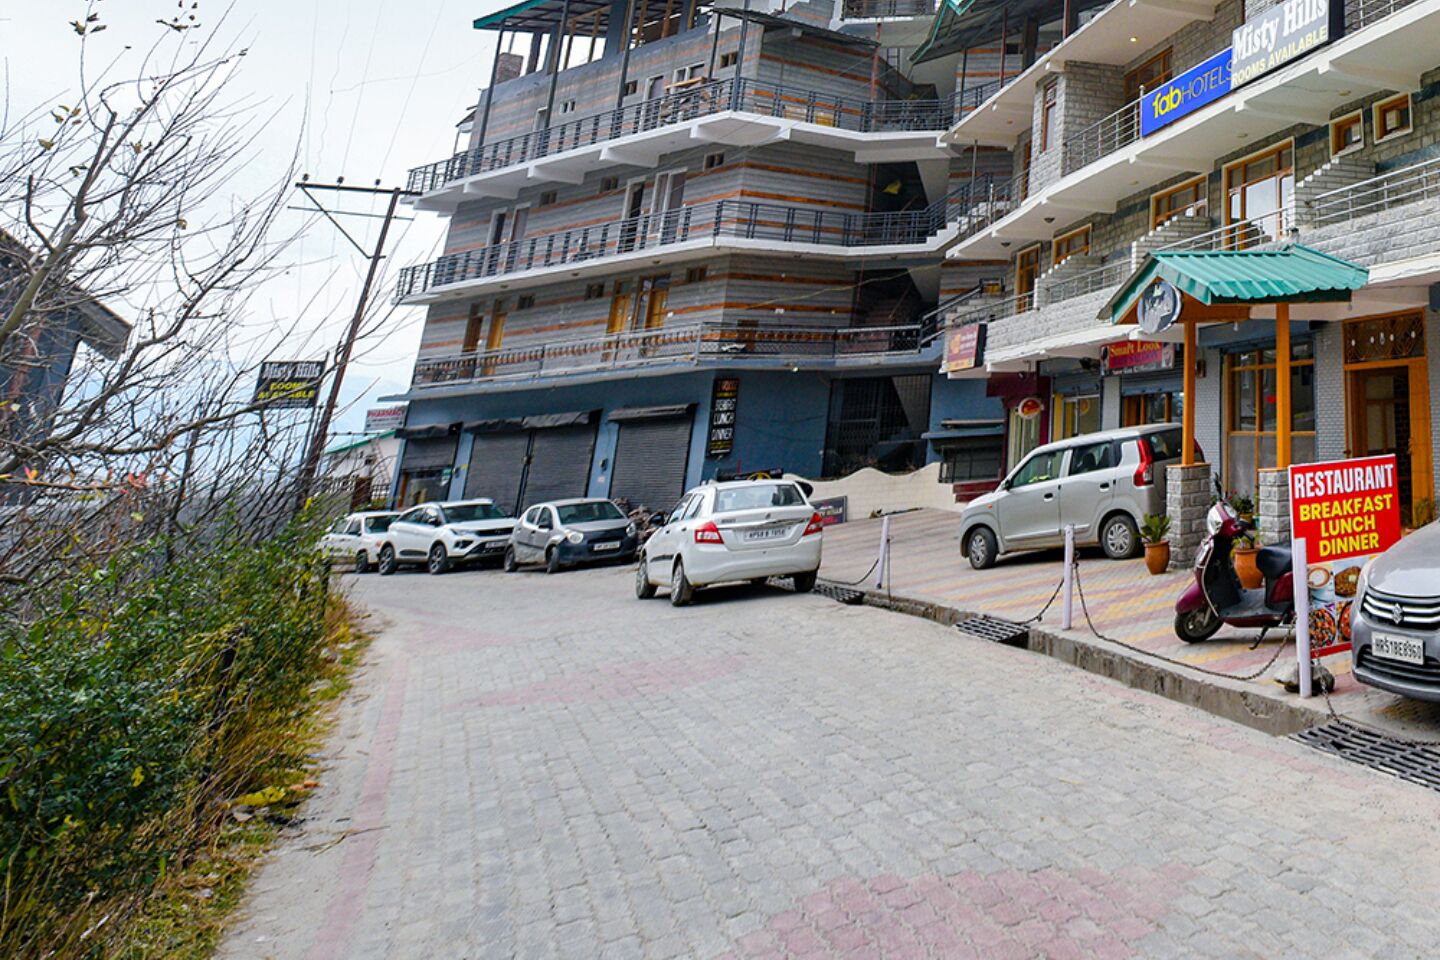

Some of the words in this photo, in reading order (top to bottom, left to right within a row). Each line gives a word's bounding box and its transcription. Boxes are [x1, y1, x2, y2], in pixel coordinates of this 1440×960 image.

[1231, 58, 1266, 87] ROOMS
[1268, 25, 1327, 69] AVAILABLE
[1233, 17, 1280, 65] Misty
[1294, 464, 1394, 499] RESTAURANT
[1299, 494, 1393, 521] BREAKFAST
[1320, 515, 1376, 537] LUNCH
[1319, 533, 1380, 557] DINNER
